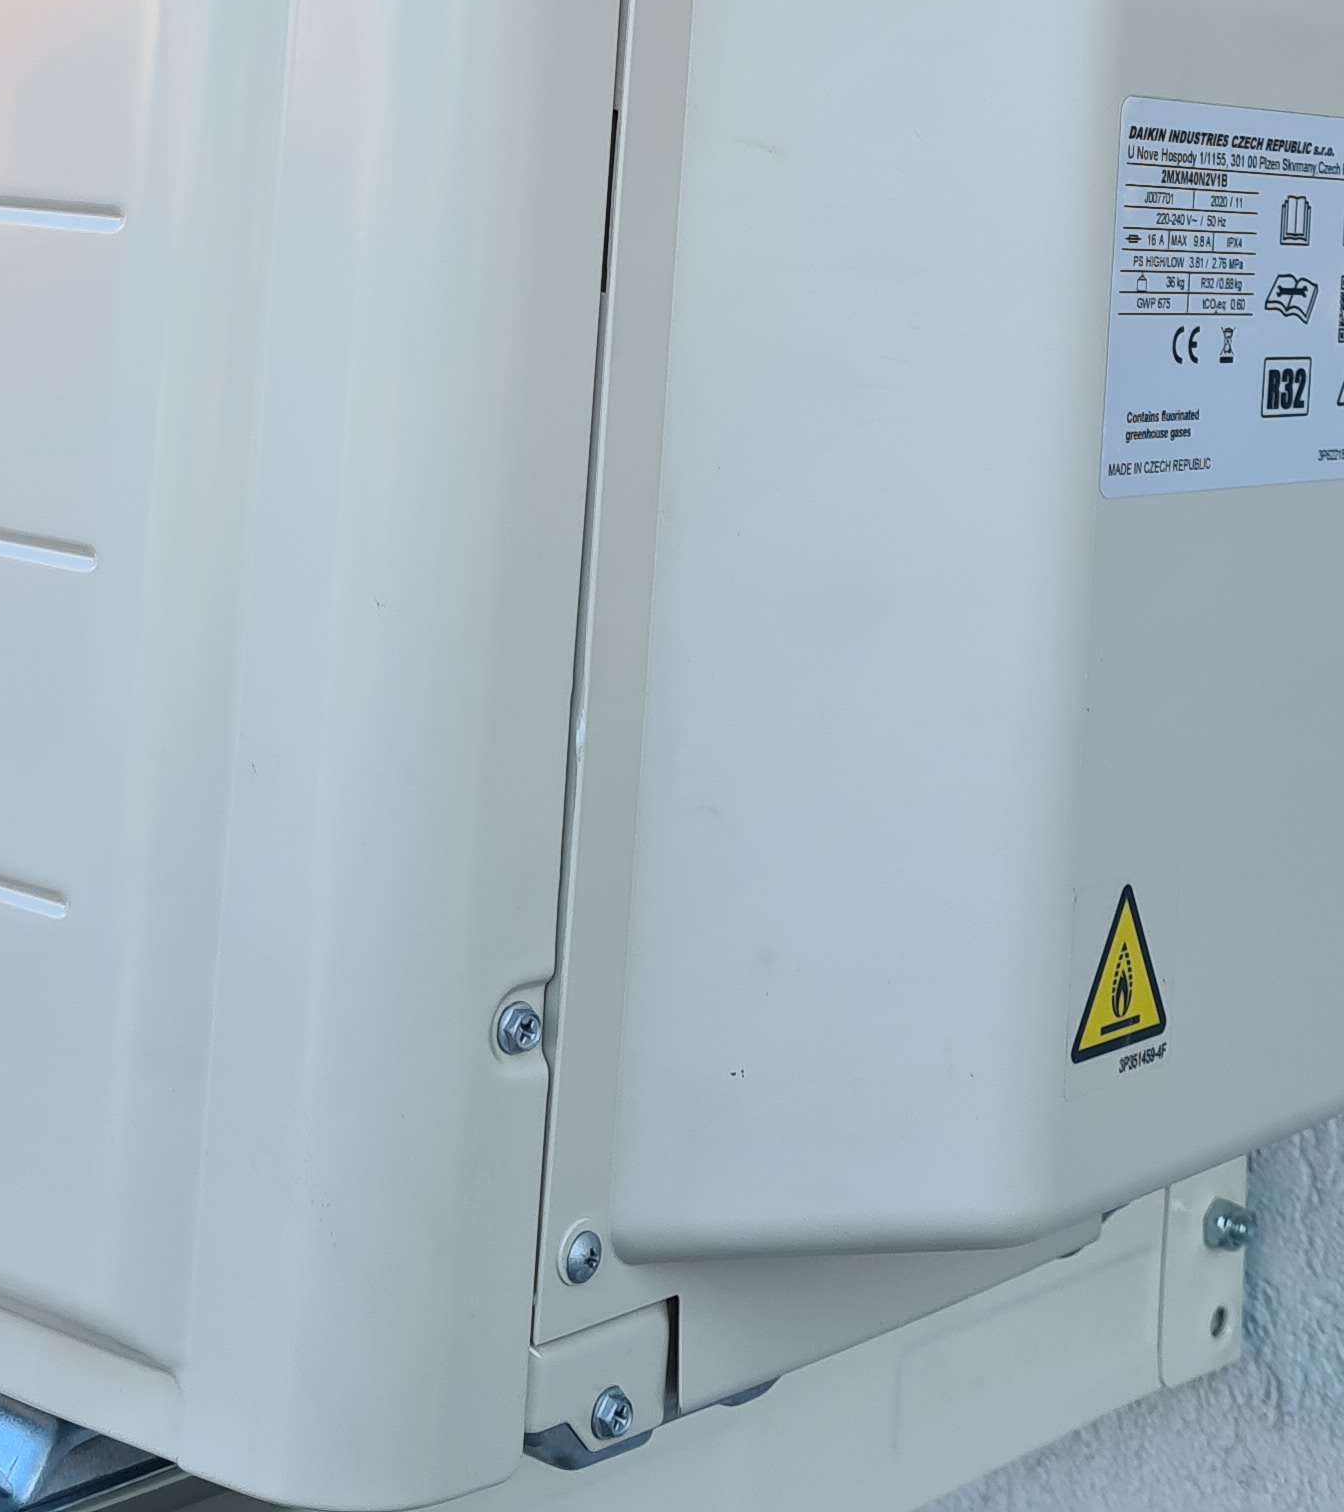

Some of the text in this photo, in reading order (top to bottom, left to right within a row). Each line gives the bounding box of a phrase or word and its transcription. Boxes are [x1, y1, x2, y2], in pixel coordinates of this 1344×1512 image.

[1128, 125, 1335, 157] DAIKIN INDUSTRIES CZECH REPUBLIC s.r.o.
[1127, 144, 1135, 159] U
[1137, 145, 1158, 161] Nove
[1161, 148, 1197, 166] Hospody
[1199, 151, 1229, 168] 1/1155,
[1230, 154, 1245, 168] 301
[1247, 155, 1258, 169] 00
[1259, 156, 1280, 171] Plzen
[1161, 169, 1228, 188] 2MXM40N2V1B
[1210, 195, 1228, 208] 2020
[1235, 197, 1243, 208] 11
[1156, 212, 1186, 226] 220-240
[1207, 215, 1216, 227] 50
[1217, 216, 1227, 227] Hz
[1147, 234, 1157, 246] 16
[1159, 234, 1165, 246] A
[1171, 235, 1187, 246] MAX
[1205, 236, 1211, 247] A
[1226, 237, 1243, 248] IPX4
[1133, 256, 1144, 267] PS
[1146, 256, 1185, 268] HIGH/LOW
[1228, 259, 1244, 270] MPa
[1166, 276, 1176, 288] 36
[1176, 277, 1185, 290] kg
[1201, 278, 1215, 289] R32
[1234, 279, 1243, 292] kg
[1136, 297, 1157, 310] GWP
[1157, 298, 1171, 310] 675
[1172, 326, 1201, 365] CE
[1267, 368, 1306, 410] R32
[1126, 408, 1200, 424] Contains fluorinated
[1125, 427, 1192, 444] greenhouse gases
[1108, 457, 1211, 477] MADE IN CZECH REPUBLIC
